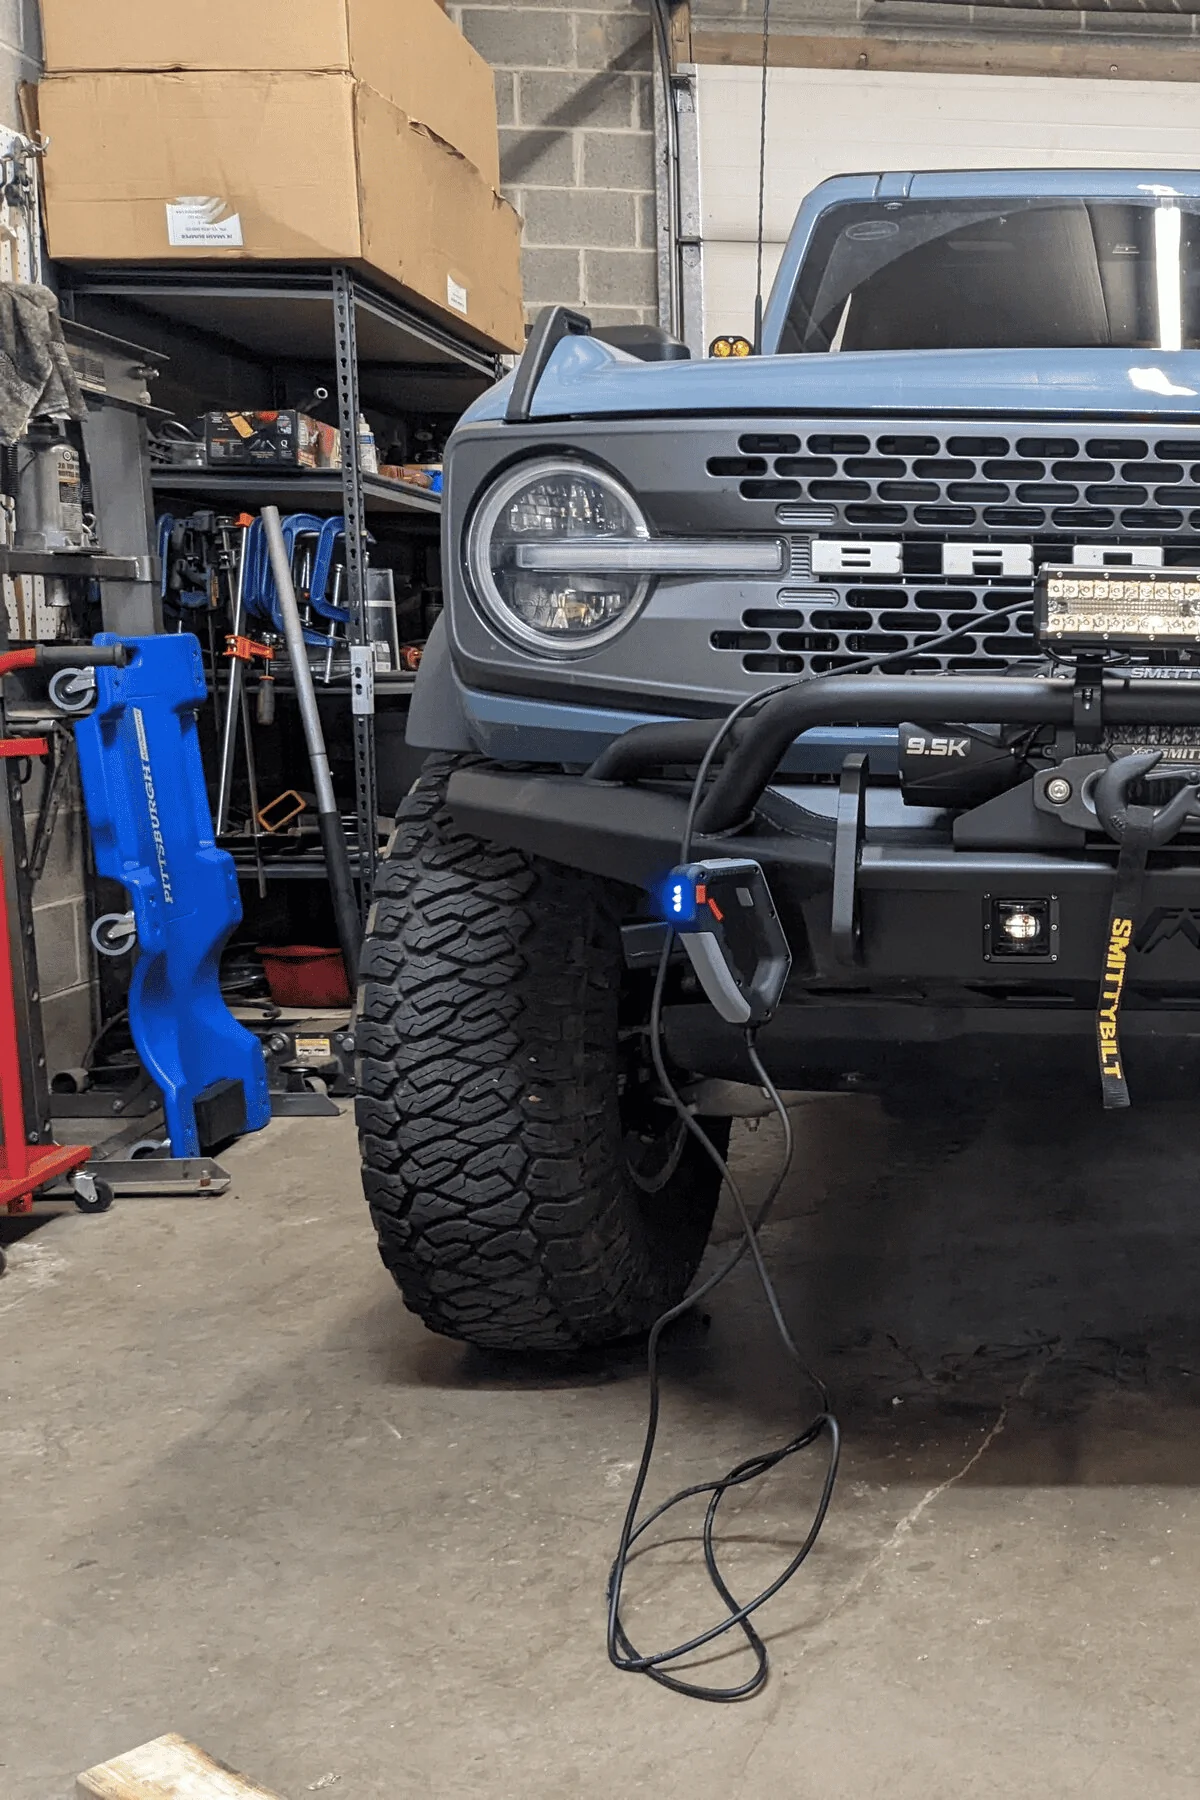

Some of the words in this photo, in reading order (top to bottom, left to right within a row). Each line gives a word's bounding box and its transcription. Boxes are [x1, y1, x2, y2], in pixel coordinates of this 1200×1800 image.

[905, 738, 970, 758] 9.5K
[142, 764, 174, 904] PITTSBURGH
[1099, 918, 1133, 1080] SMITTYBILT
